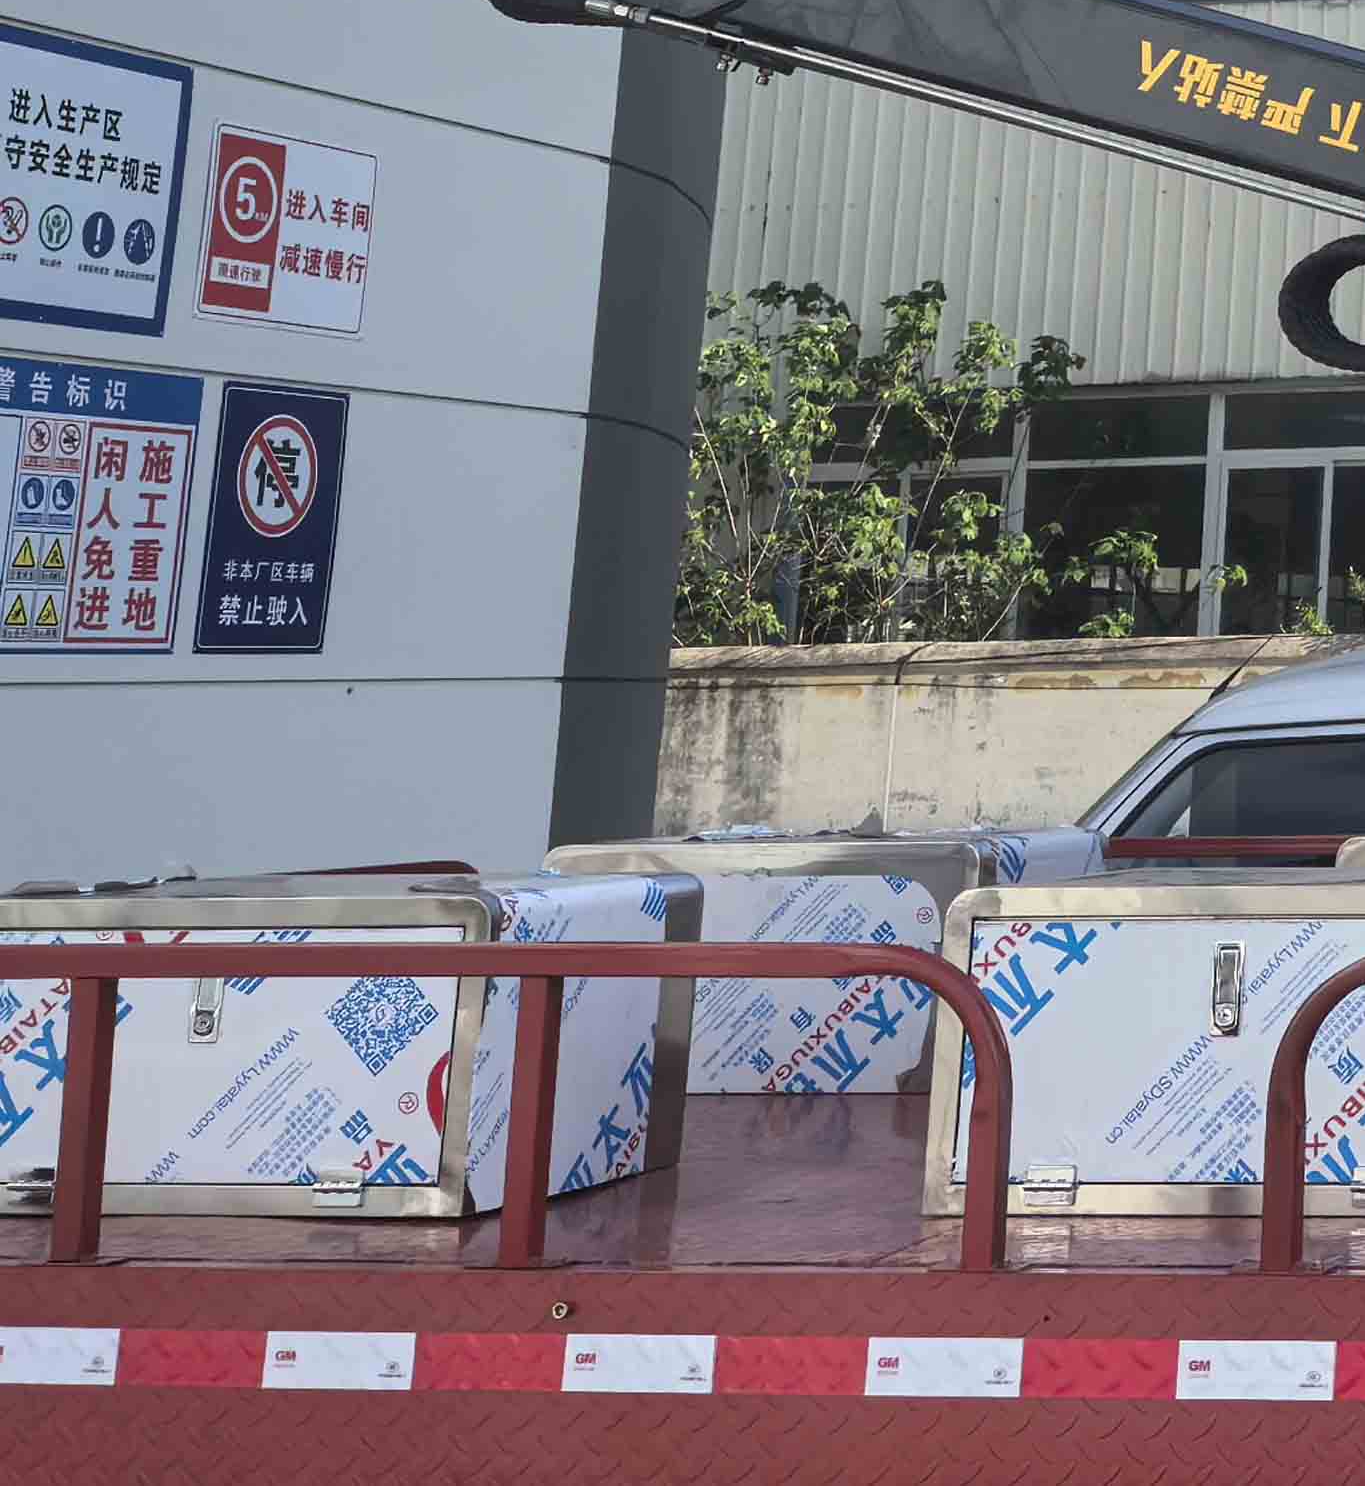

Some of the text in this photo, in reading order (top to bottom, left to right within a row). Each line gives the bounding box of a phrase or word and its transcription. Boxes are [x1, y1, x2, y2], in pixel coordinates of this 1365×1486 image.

[9, 88, 123, 142] 进入生产区
[0, 134, 162, 195] 守安全生产规定
[285, 189, 370, 232] 进入车间
[279, 244, 366, 283] 减速慢行
[74, 437, 128, 631] 闲人免进
[122, 440, 175, 631] 施工重地
[224, 560, 314, 583] 非本厂区车辆
[218, 594, 308, 627] 禁止驶入
[276, 1350, 297, 1361] GM
[576, 1353, 597, 1364] GM
[878, 1357, 899, 1368] GM
[1189, 1360, 1210, 1371] GM
